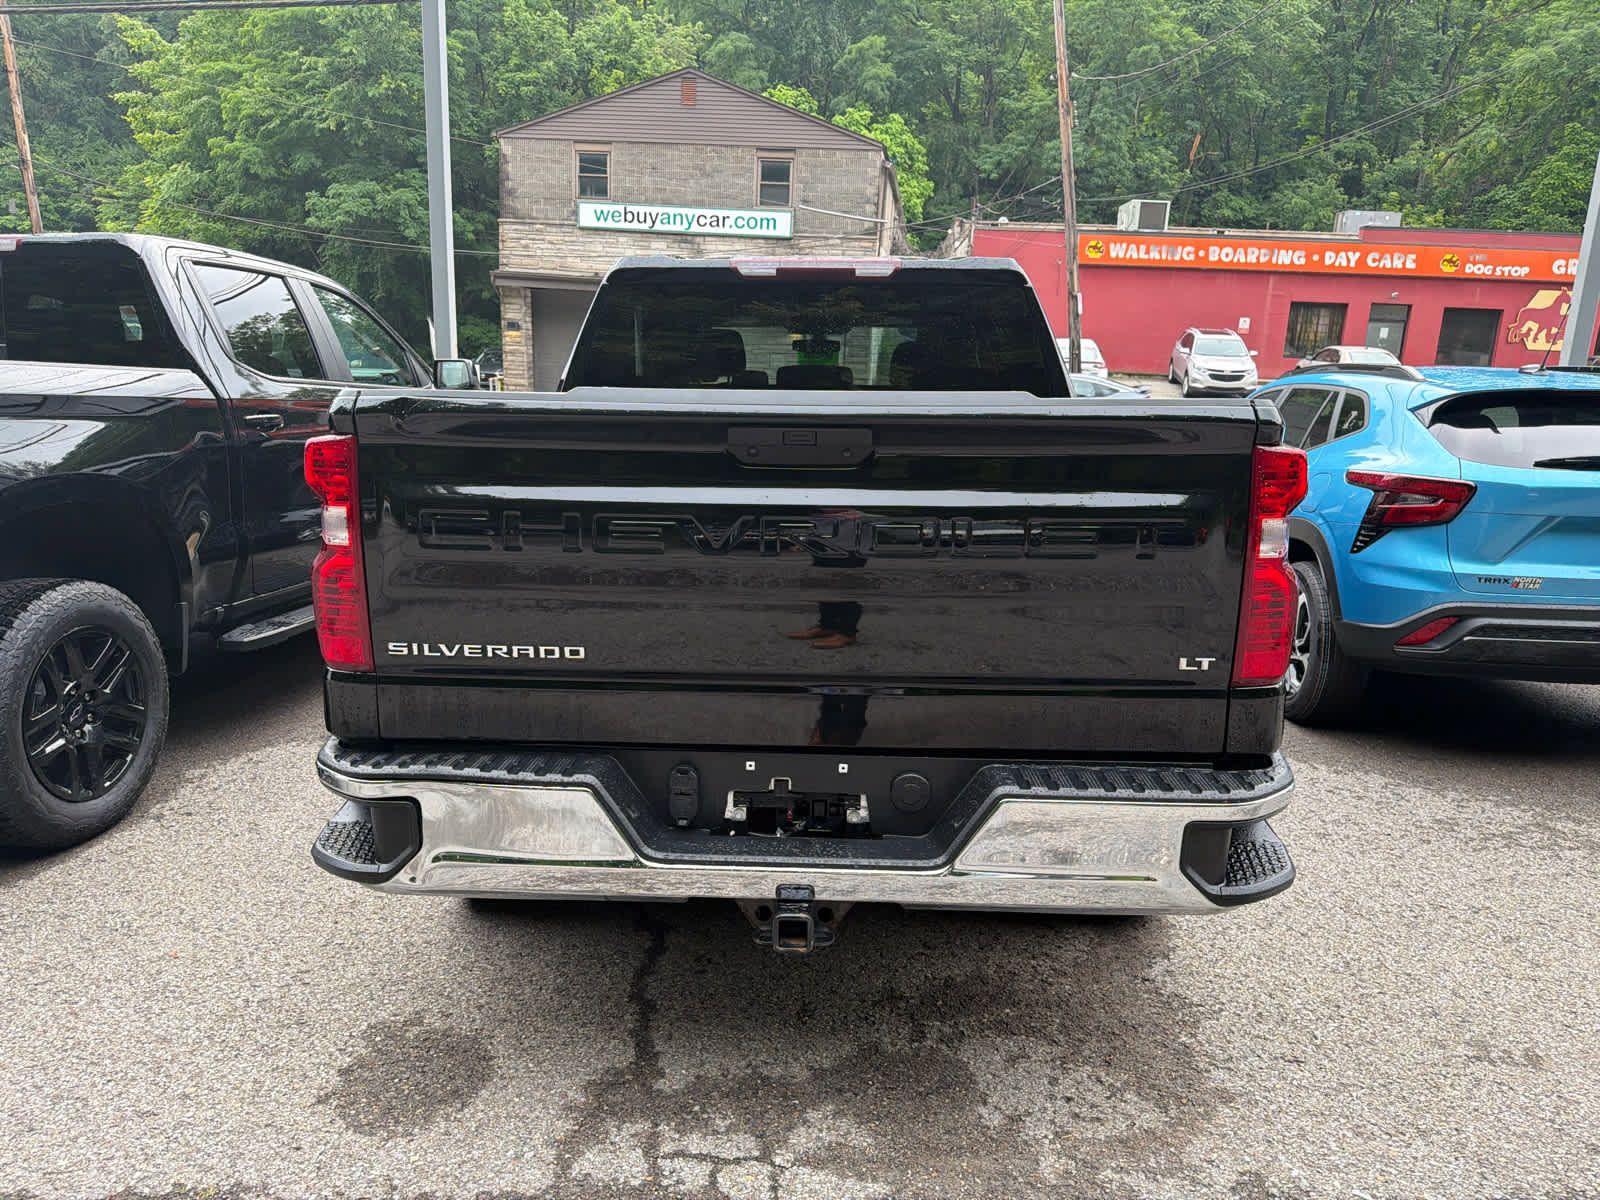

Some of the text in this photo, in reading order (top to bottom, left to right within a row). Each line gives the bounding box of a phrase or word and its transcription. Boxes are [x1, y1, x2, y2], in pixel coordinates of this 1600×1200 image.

[593, 206, 777, 231] webuyanycar.com
[1109, 242, 1417, 269] WALKING BOARDING DAY CARE
[1464, 263, 1530, 277] DOG STOP
[418, 508, 1200, 563] CHEVROLET
[1477, 576, 1543, 584] TRAX NORTH
[387, 642, 586, 659] SILVERADO
[1178, 657, 1217, 670] LT
